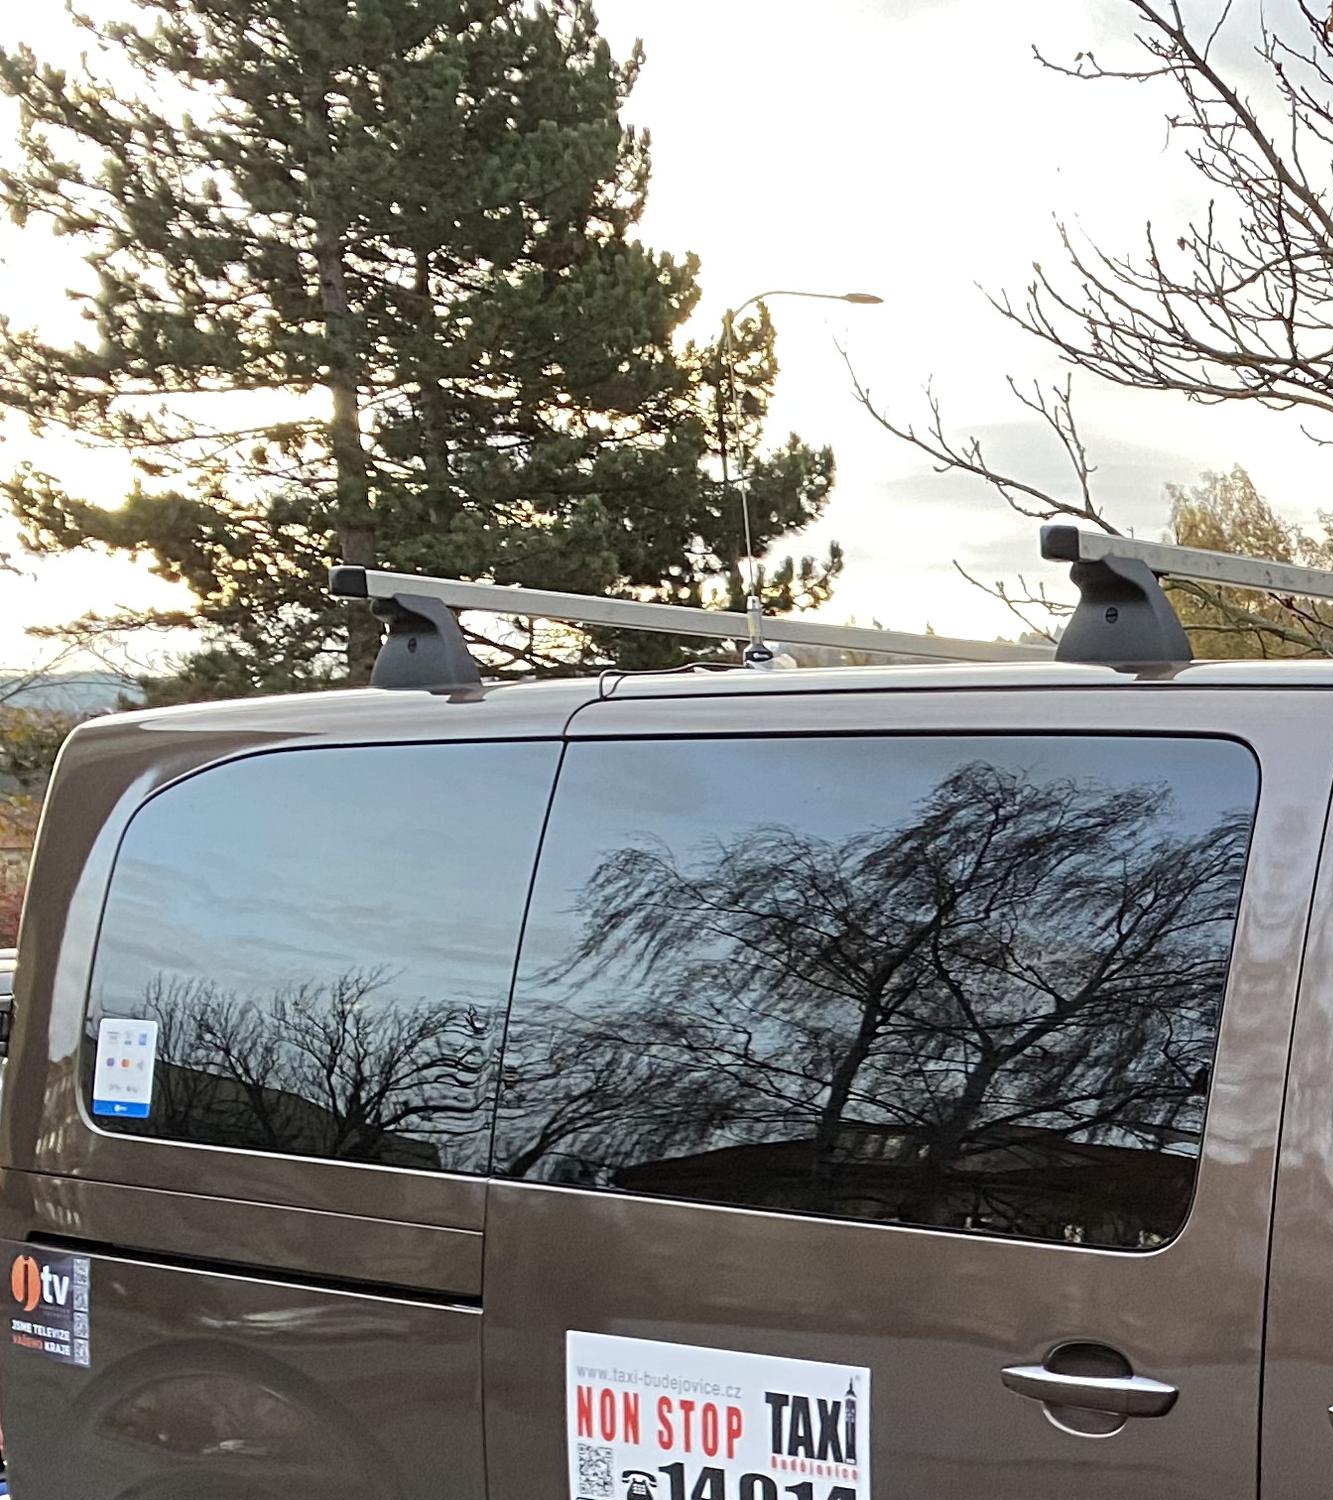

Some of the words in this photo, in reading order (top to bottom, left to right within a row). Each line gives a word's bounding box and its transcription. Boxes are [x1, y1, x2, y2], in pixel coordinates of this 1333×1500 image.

[576, 1365, 742, 1399] www.taxi-budejovice.cz
[577, 1385, 640, 1445] NON
[657, 1395, 743, 1459] STOP
